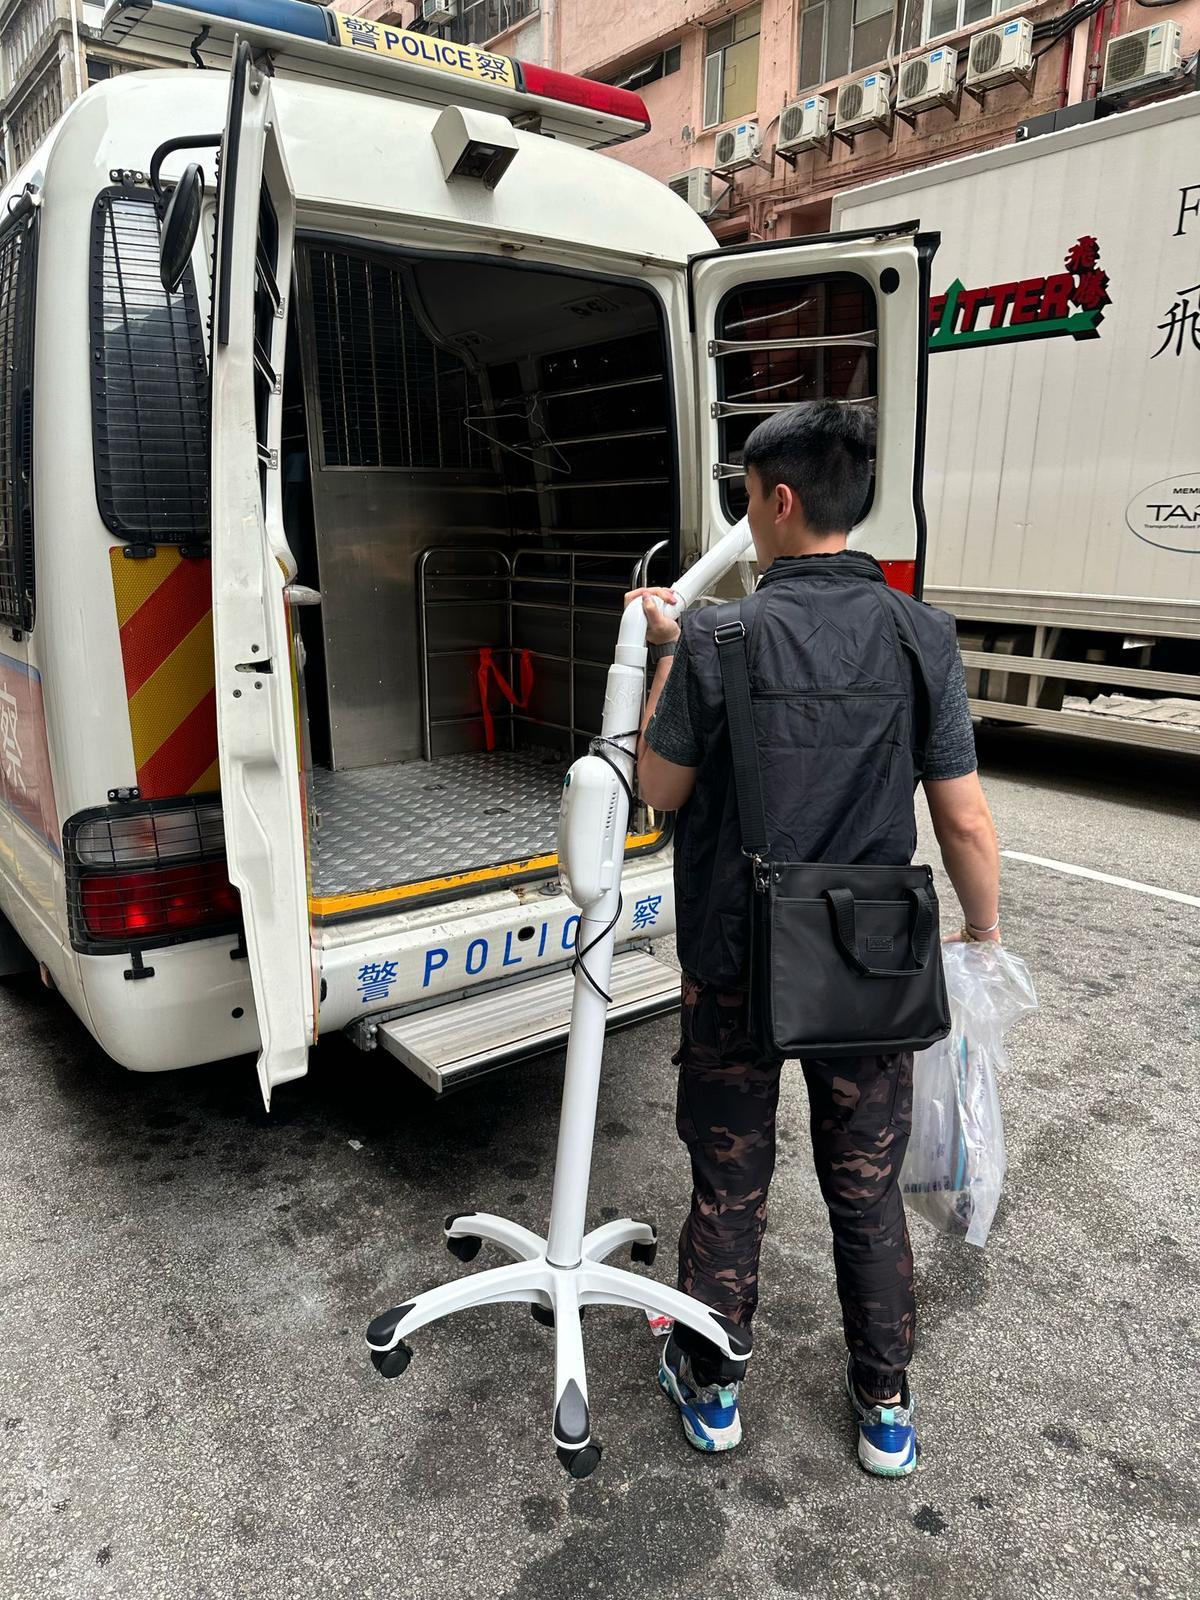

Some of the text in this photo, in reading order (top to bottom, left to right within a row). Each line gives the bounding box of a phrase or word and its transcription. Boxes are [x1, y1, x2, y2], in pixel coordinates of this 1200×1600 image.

[342, 16, 510, 83] 警 POLICE 察
[1172, 184, 1200, 236] F
[1173, 487, 1200, 495] MEM
[357, 895, 662, 1004] 警 POLIC 察
